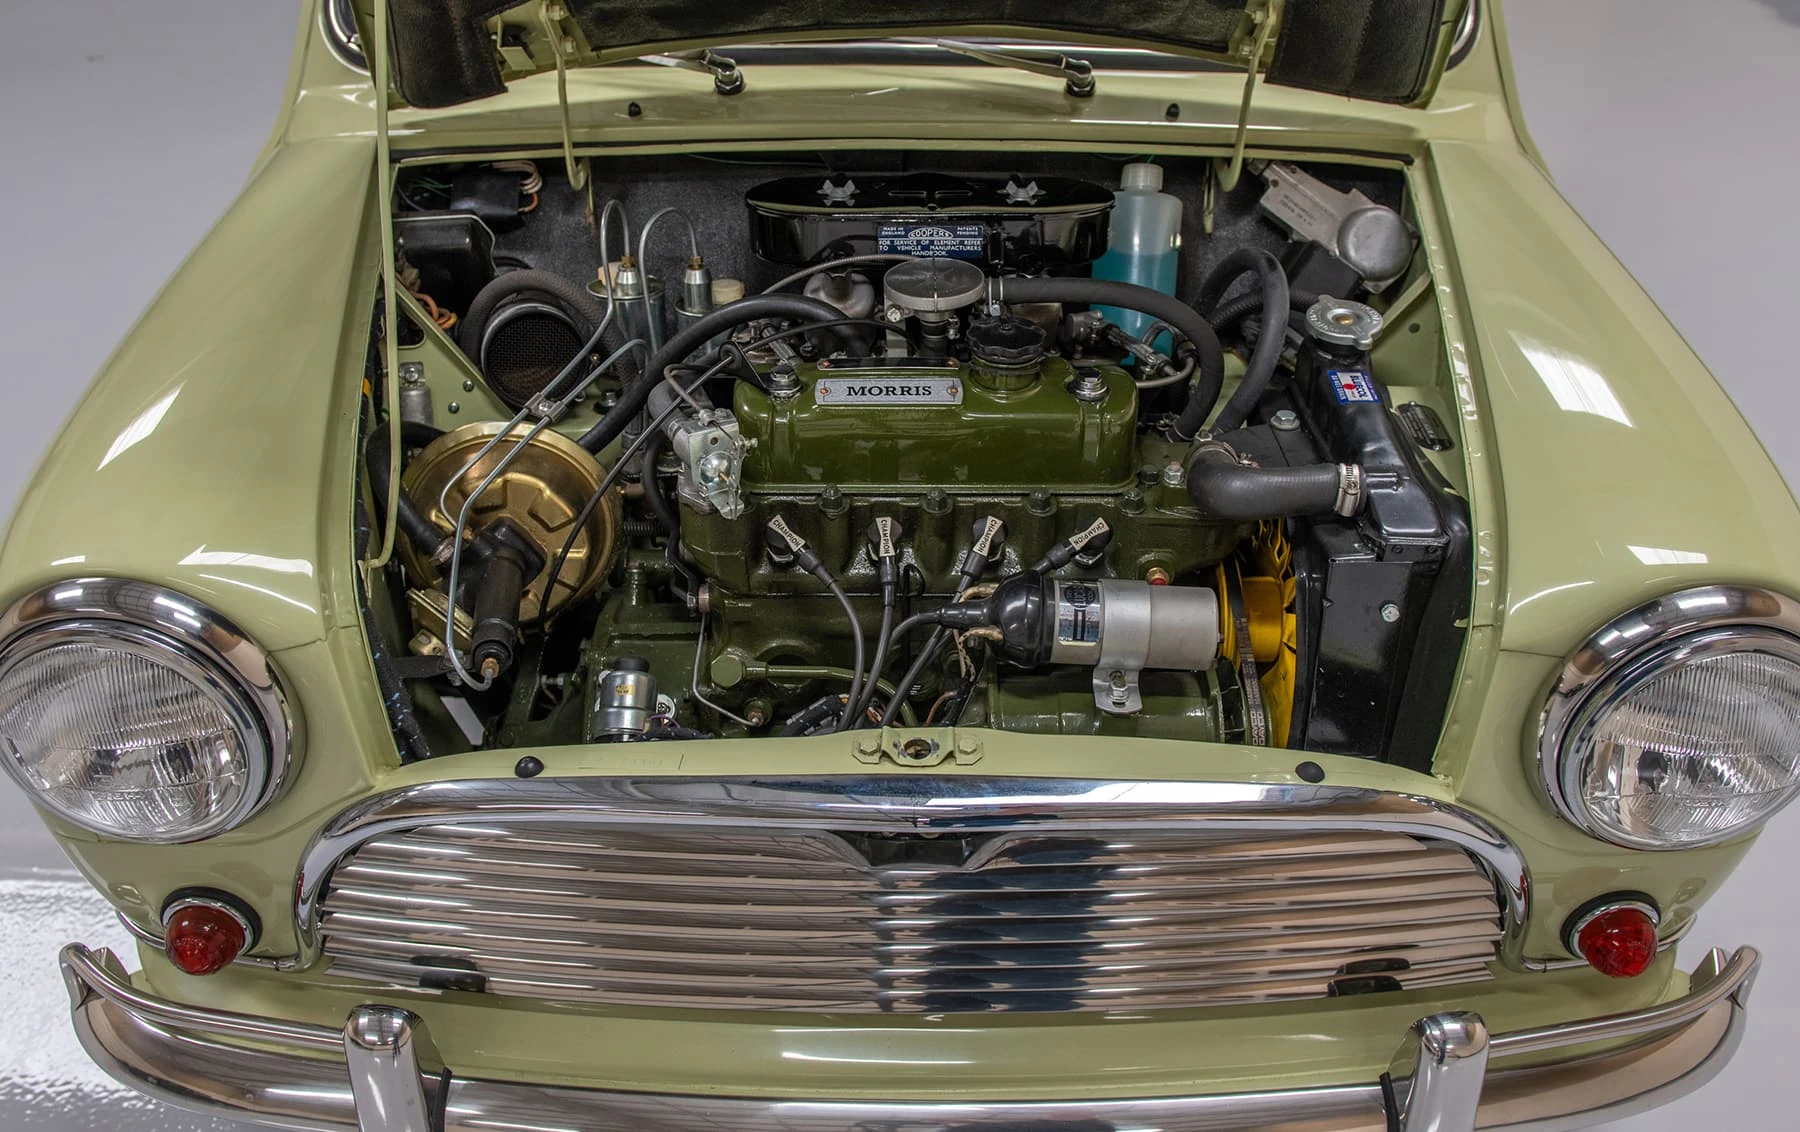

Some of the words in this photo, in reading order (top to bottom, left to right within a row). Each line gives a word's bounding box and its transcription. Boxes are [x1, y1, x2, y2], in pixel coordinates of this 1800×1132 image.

[846, 385, 933, 397] MORRIS
[772, 519, 801, 548] CHAMPION
[881, 519, 890, 555] CHAMPION
[978, 519, 998, 553] CHAMPION
[1073, 522, 1105, 546] CHAMPION
